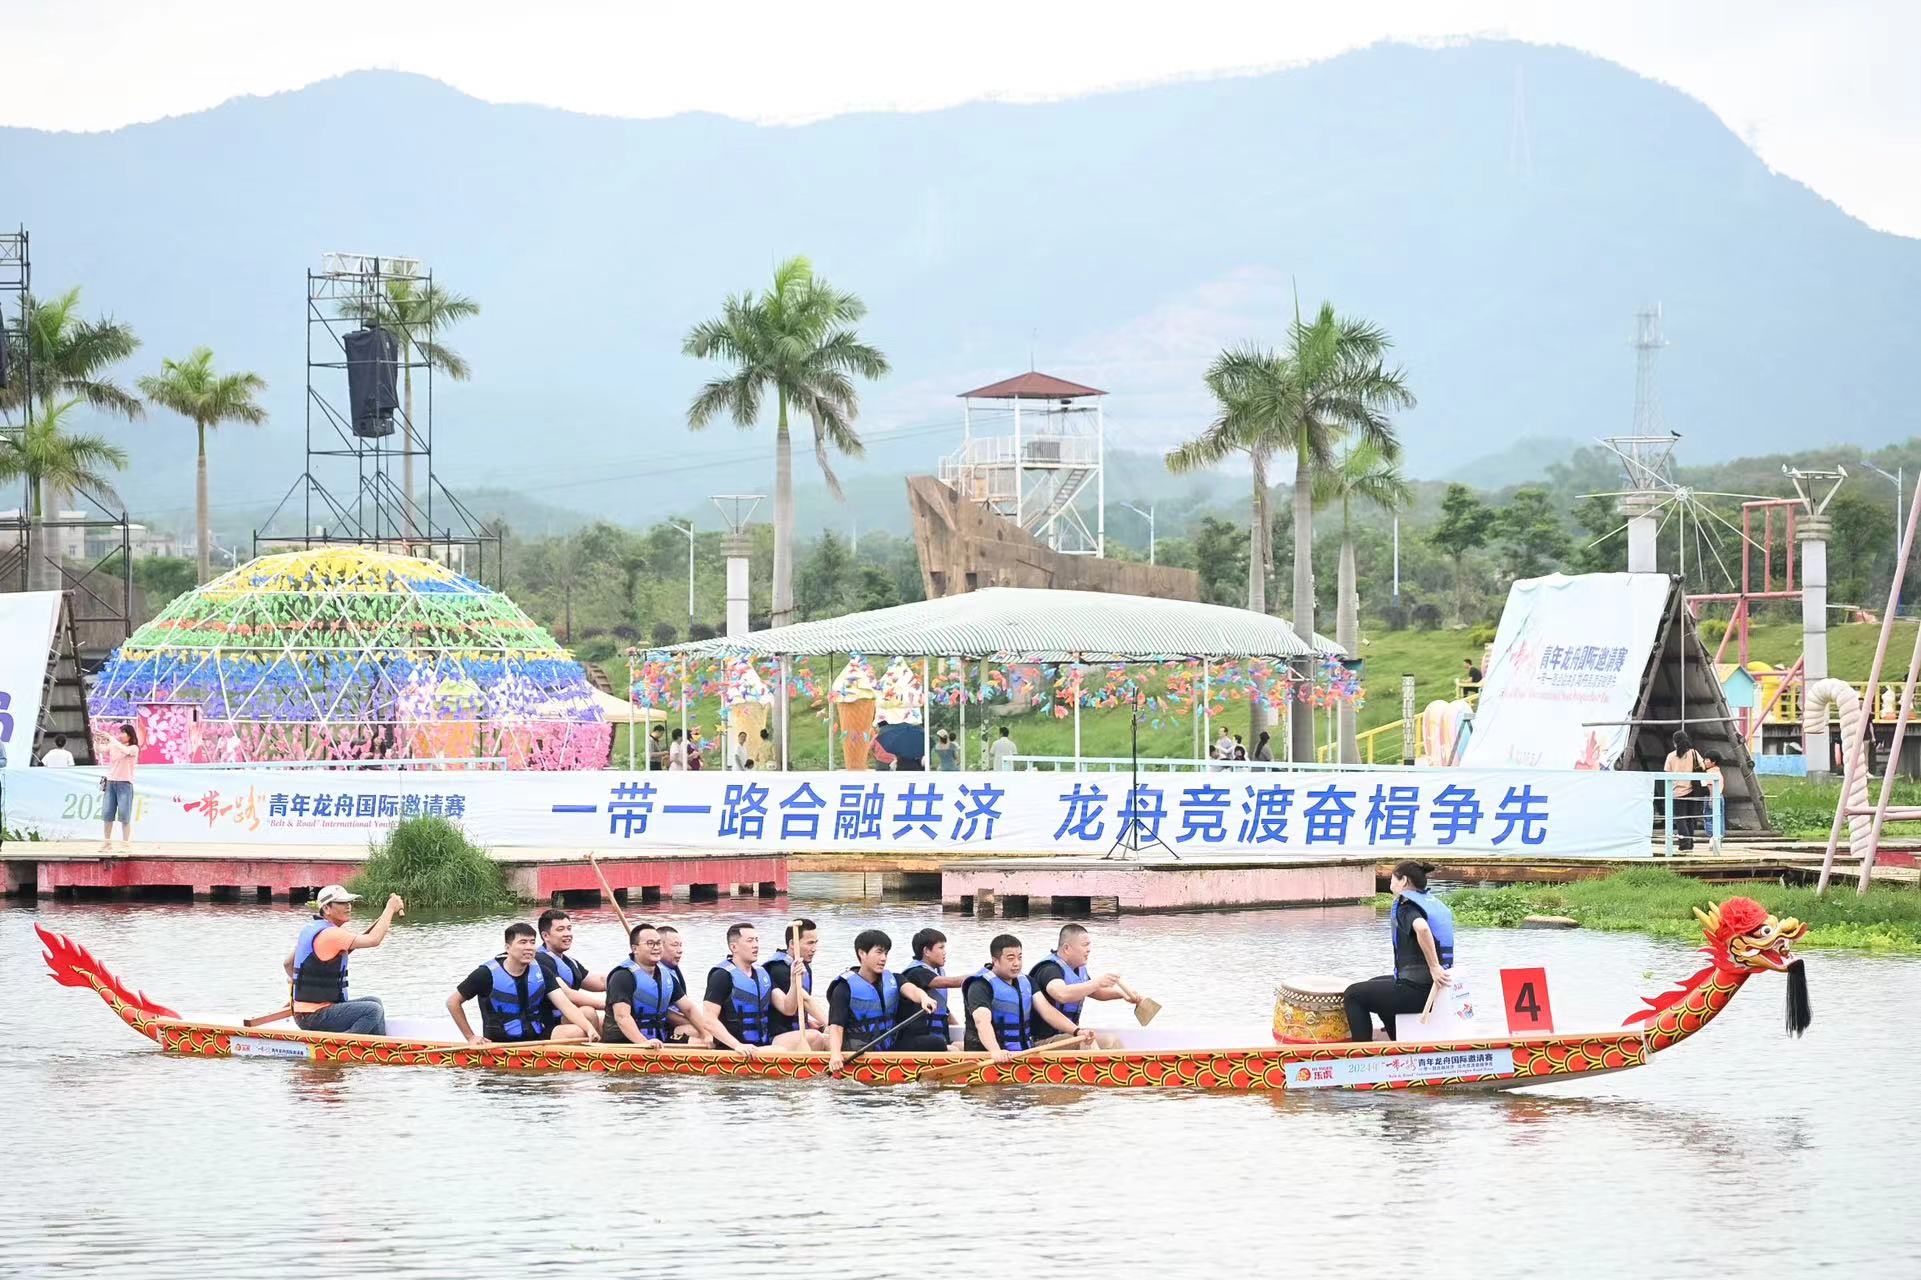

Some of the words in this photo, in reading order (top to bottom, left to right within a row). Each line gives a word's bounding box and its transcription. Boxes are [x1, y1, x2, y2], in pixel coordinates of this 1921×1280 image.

[269, 793, 466, 818] 青年龙舟国际邀请赛
[551, 782, 1005, 841] 一带一路合融共济
[1053, 783, 1549, 845] 龙舟竞渡奋楫争先
[322, 819, 372, 828] International
[1515, 982, 1541, 1022] 4
[1418, 1053, 1493, 1067] 青年龙舟国际邀请赛
